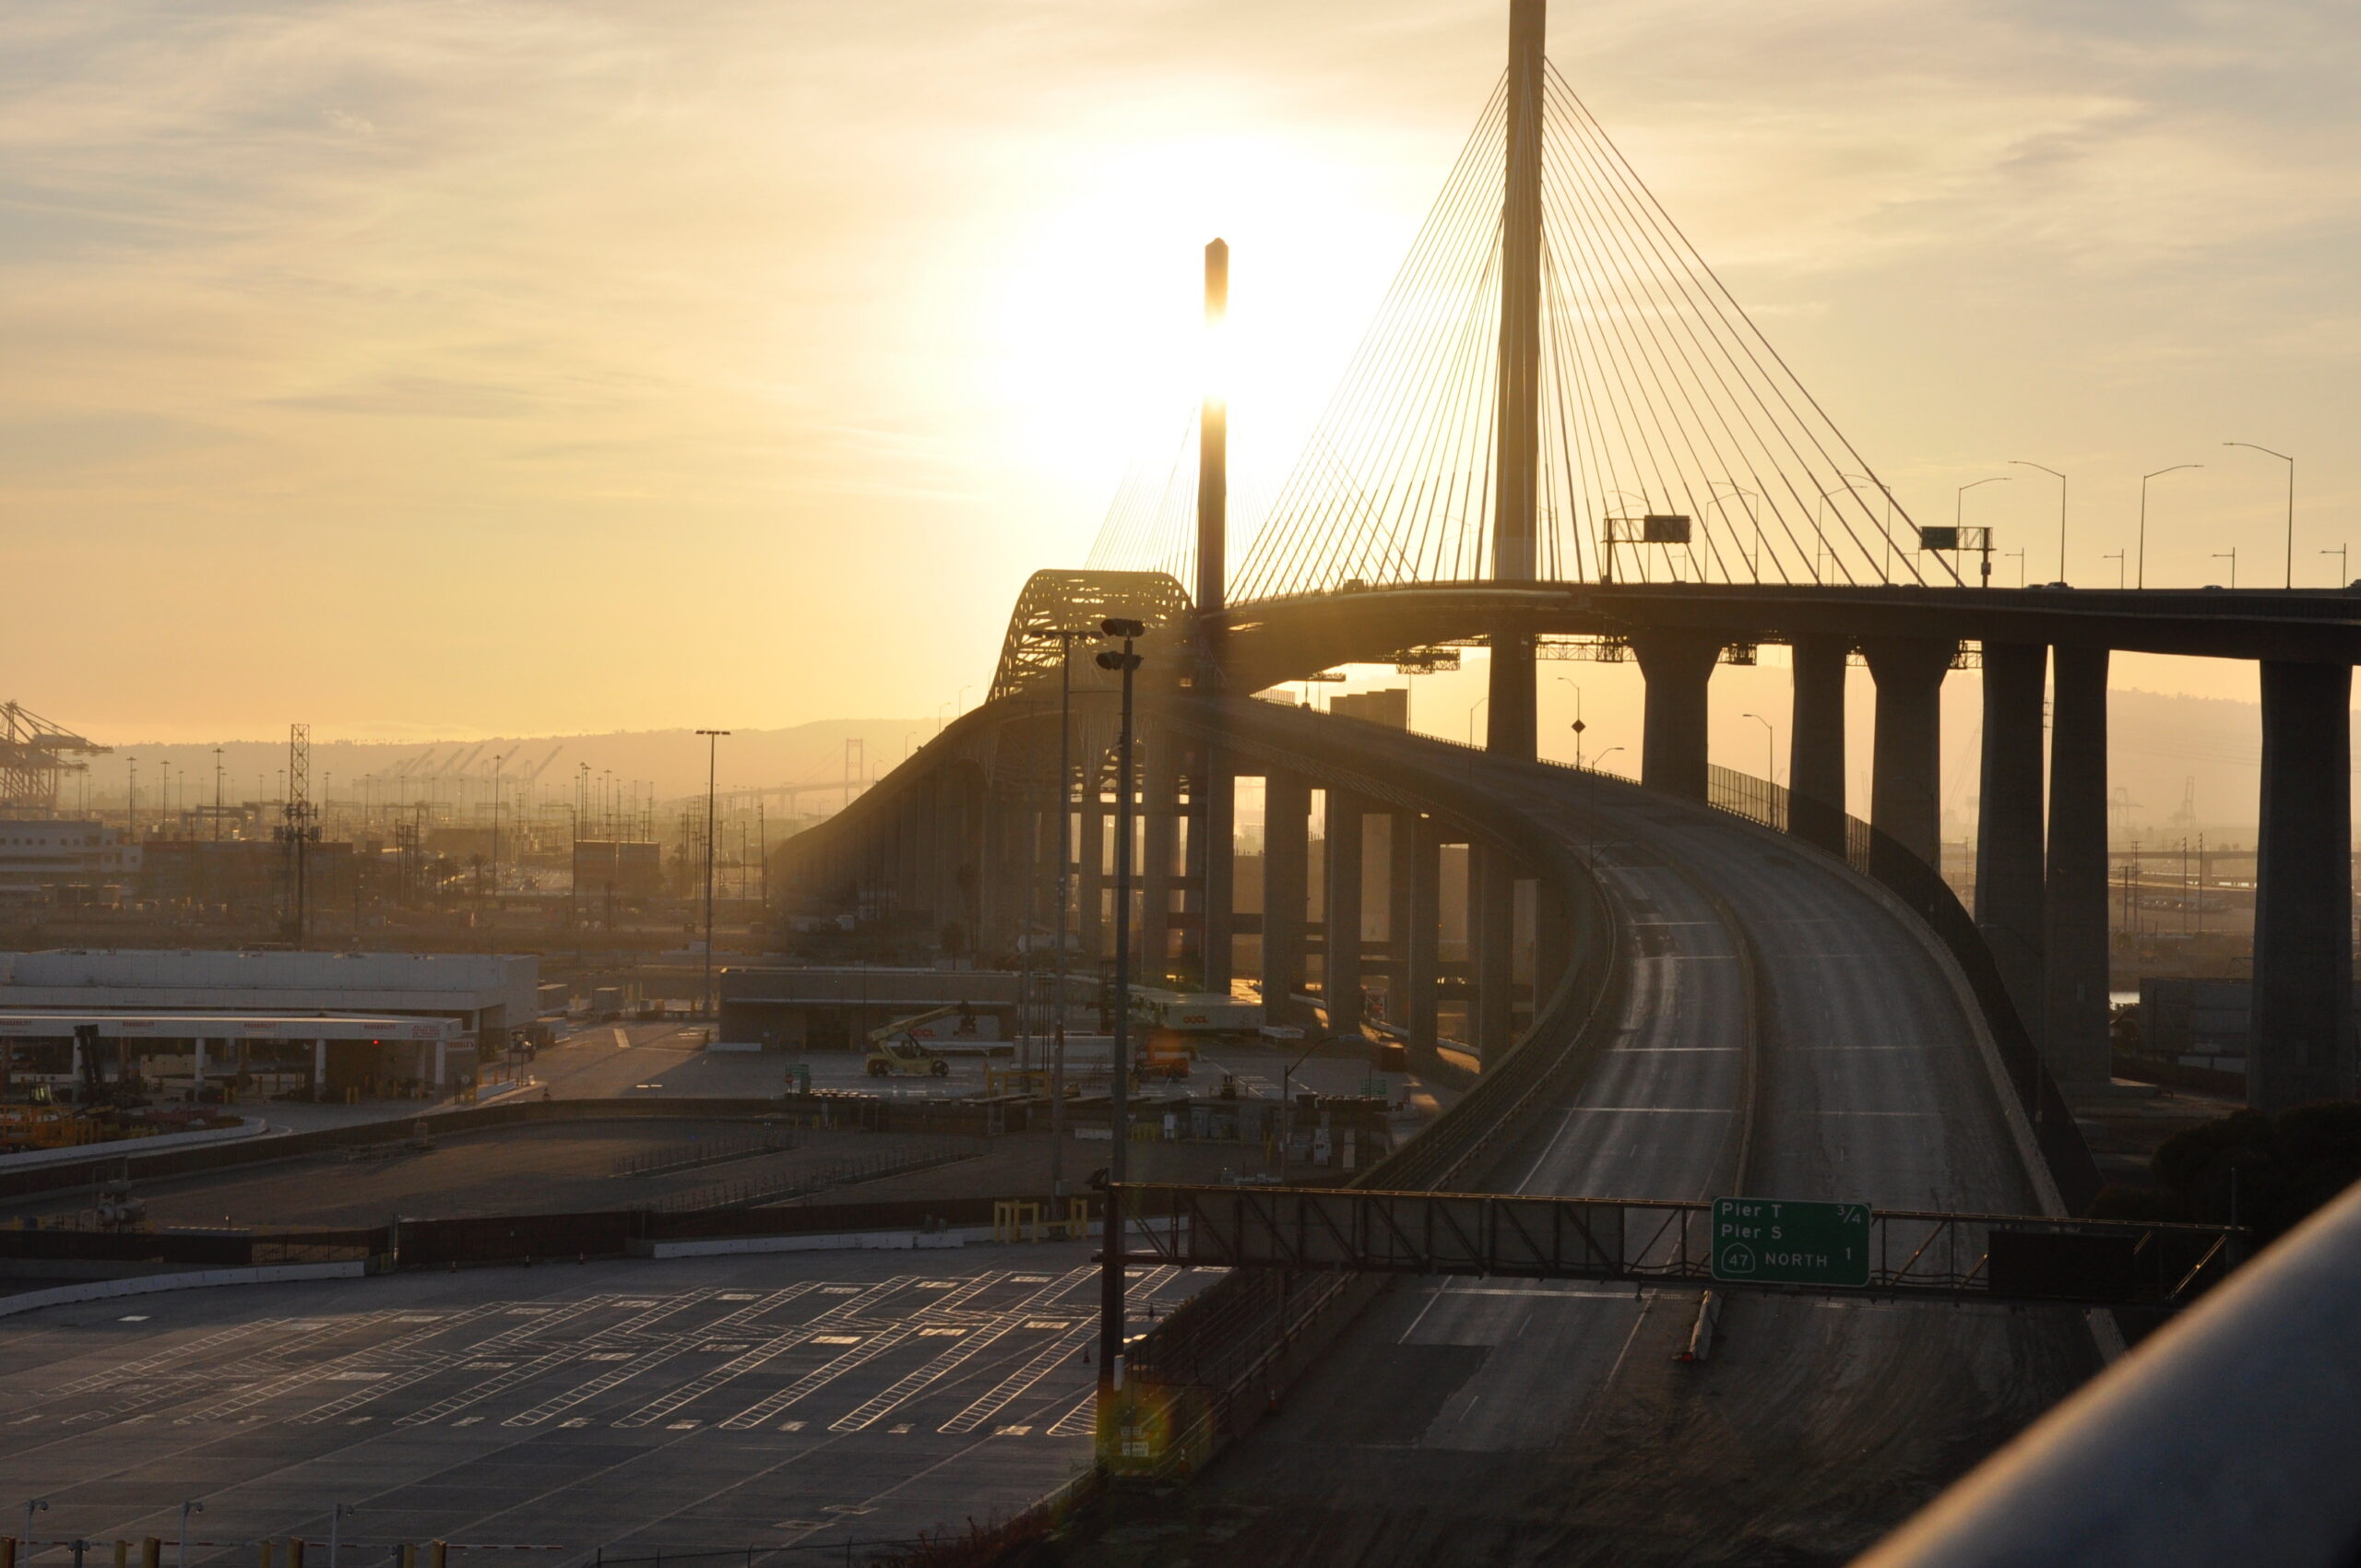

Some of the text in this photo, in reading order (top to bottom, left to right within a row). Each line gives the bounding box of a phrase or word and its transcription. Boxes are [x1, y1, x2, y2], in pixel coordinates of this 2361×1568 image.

[1721, 1202, 1762, 1217] Pier
[1771, 1204, 1782, 1218] T
[1721, 1224, 1783, 1240] Pier S
[1728, 1247, 1852, 1268] 47 NORTH 1
